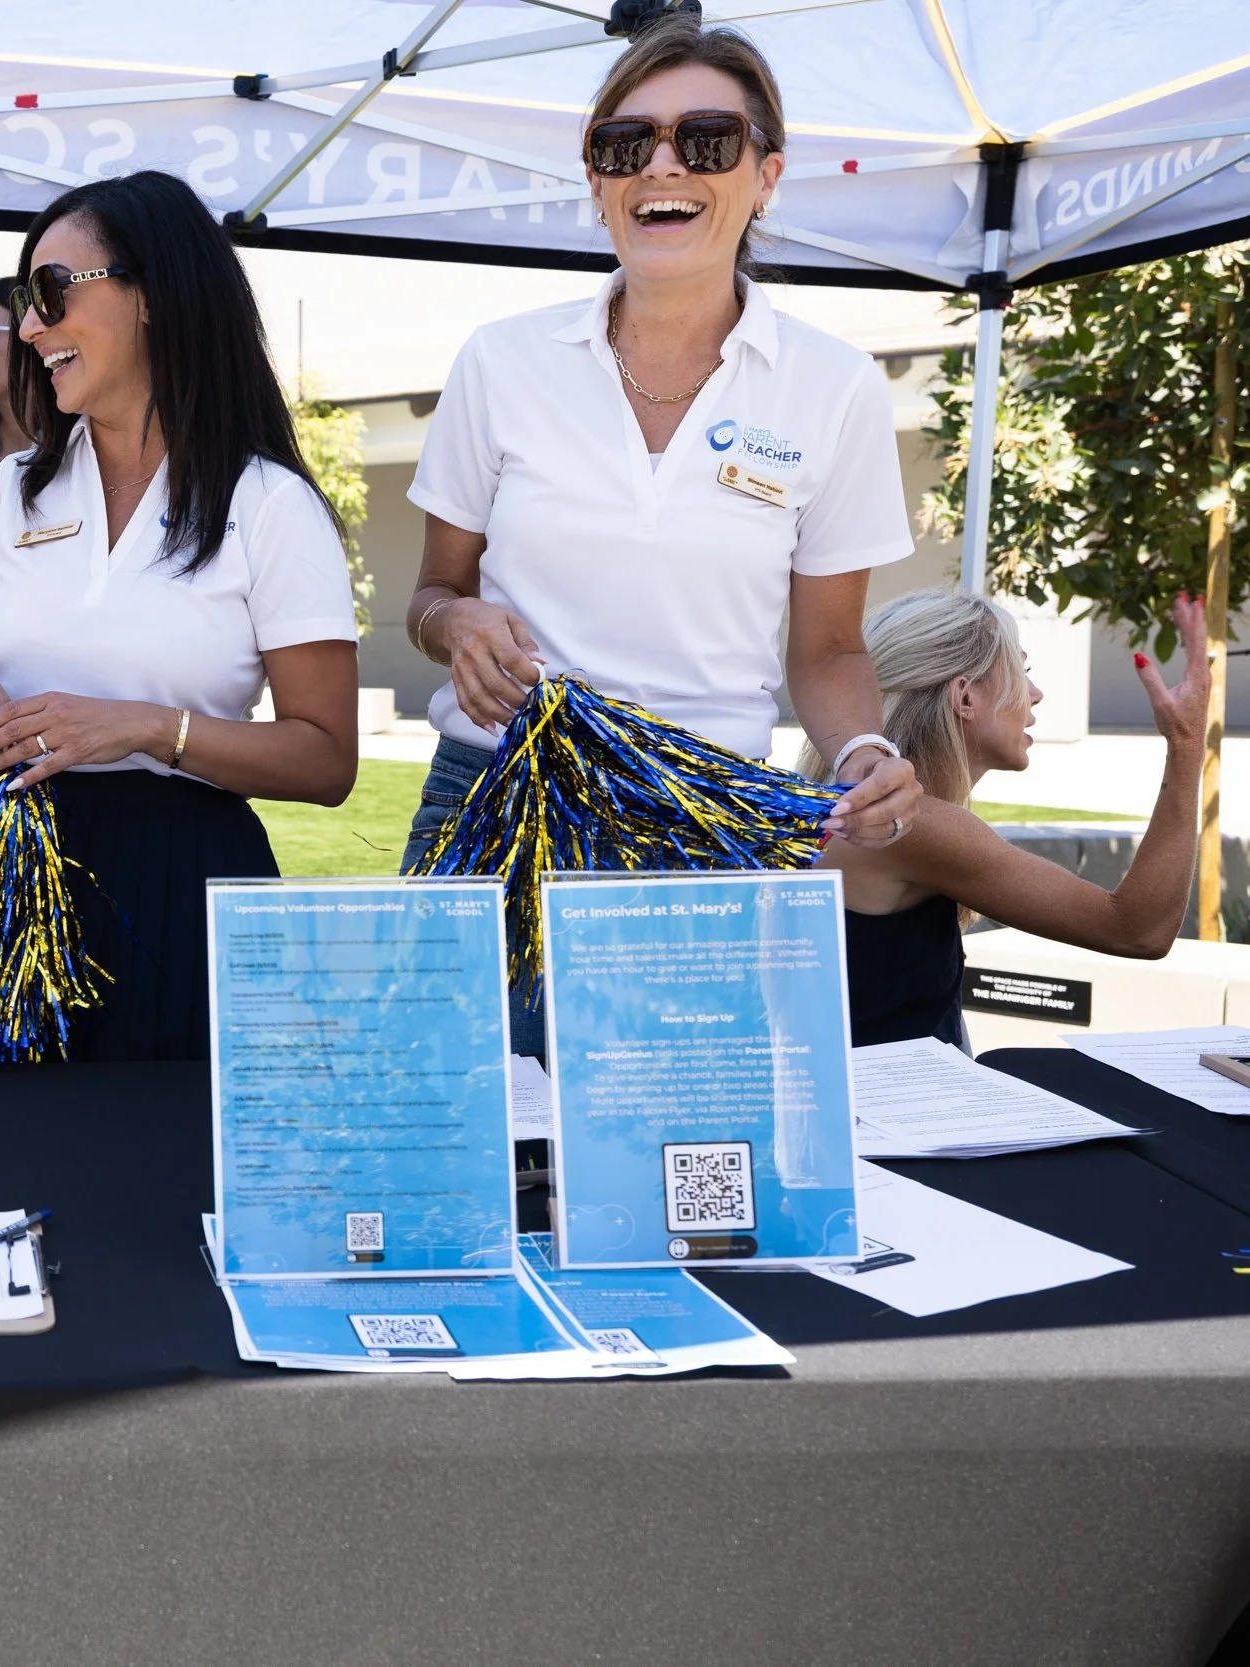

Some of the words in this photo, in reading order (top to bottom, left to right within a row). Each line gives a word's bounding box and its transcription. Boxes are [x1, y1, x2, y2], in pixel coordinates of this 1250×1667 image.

[742, 437, 802, 462] TEACHER
[797, 890, 833, 898] MARY'S
[787, 898, 827, 907] SCHOOL
[234, 904, 286, 916] Upcoming
[287, 903, 336, 912] Volunteer
[337, 901, 406, 914] Opportunities
[445, 908, 485, 916] SCHOOL
[561, 907, 587, 919] Get
[589, 905, 650, 918] Involved
[653, 906, 668, 916] at
[671, 904, 690, 915] St.
[691, 902, 742, 917] Mary's!
[617, 941, 654, 953] grateful
[654, 941, 667, 951] for
[586, 966, 608, 974] have
[623, 964, 645, 974] hour
[645, 965, 657, 973] to
[714, 962, 726, 971] to
[710, 974, 724, 982] for
[972, 988, 990, 999] THE
[1042, 998, 1075, 1010] FAMILY
[660, 1015, 684, 1024] How
[684, 1015, 696, 1023] to
[696, 1014, 719, 1024] Sign
[720, 1013, 735, 1024] Up
[586, 1050, 653, 1060] SignUpGenius
[697, 1116, 730, 1125] Parent
